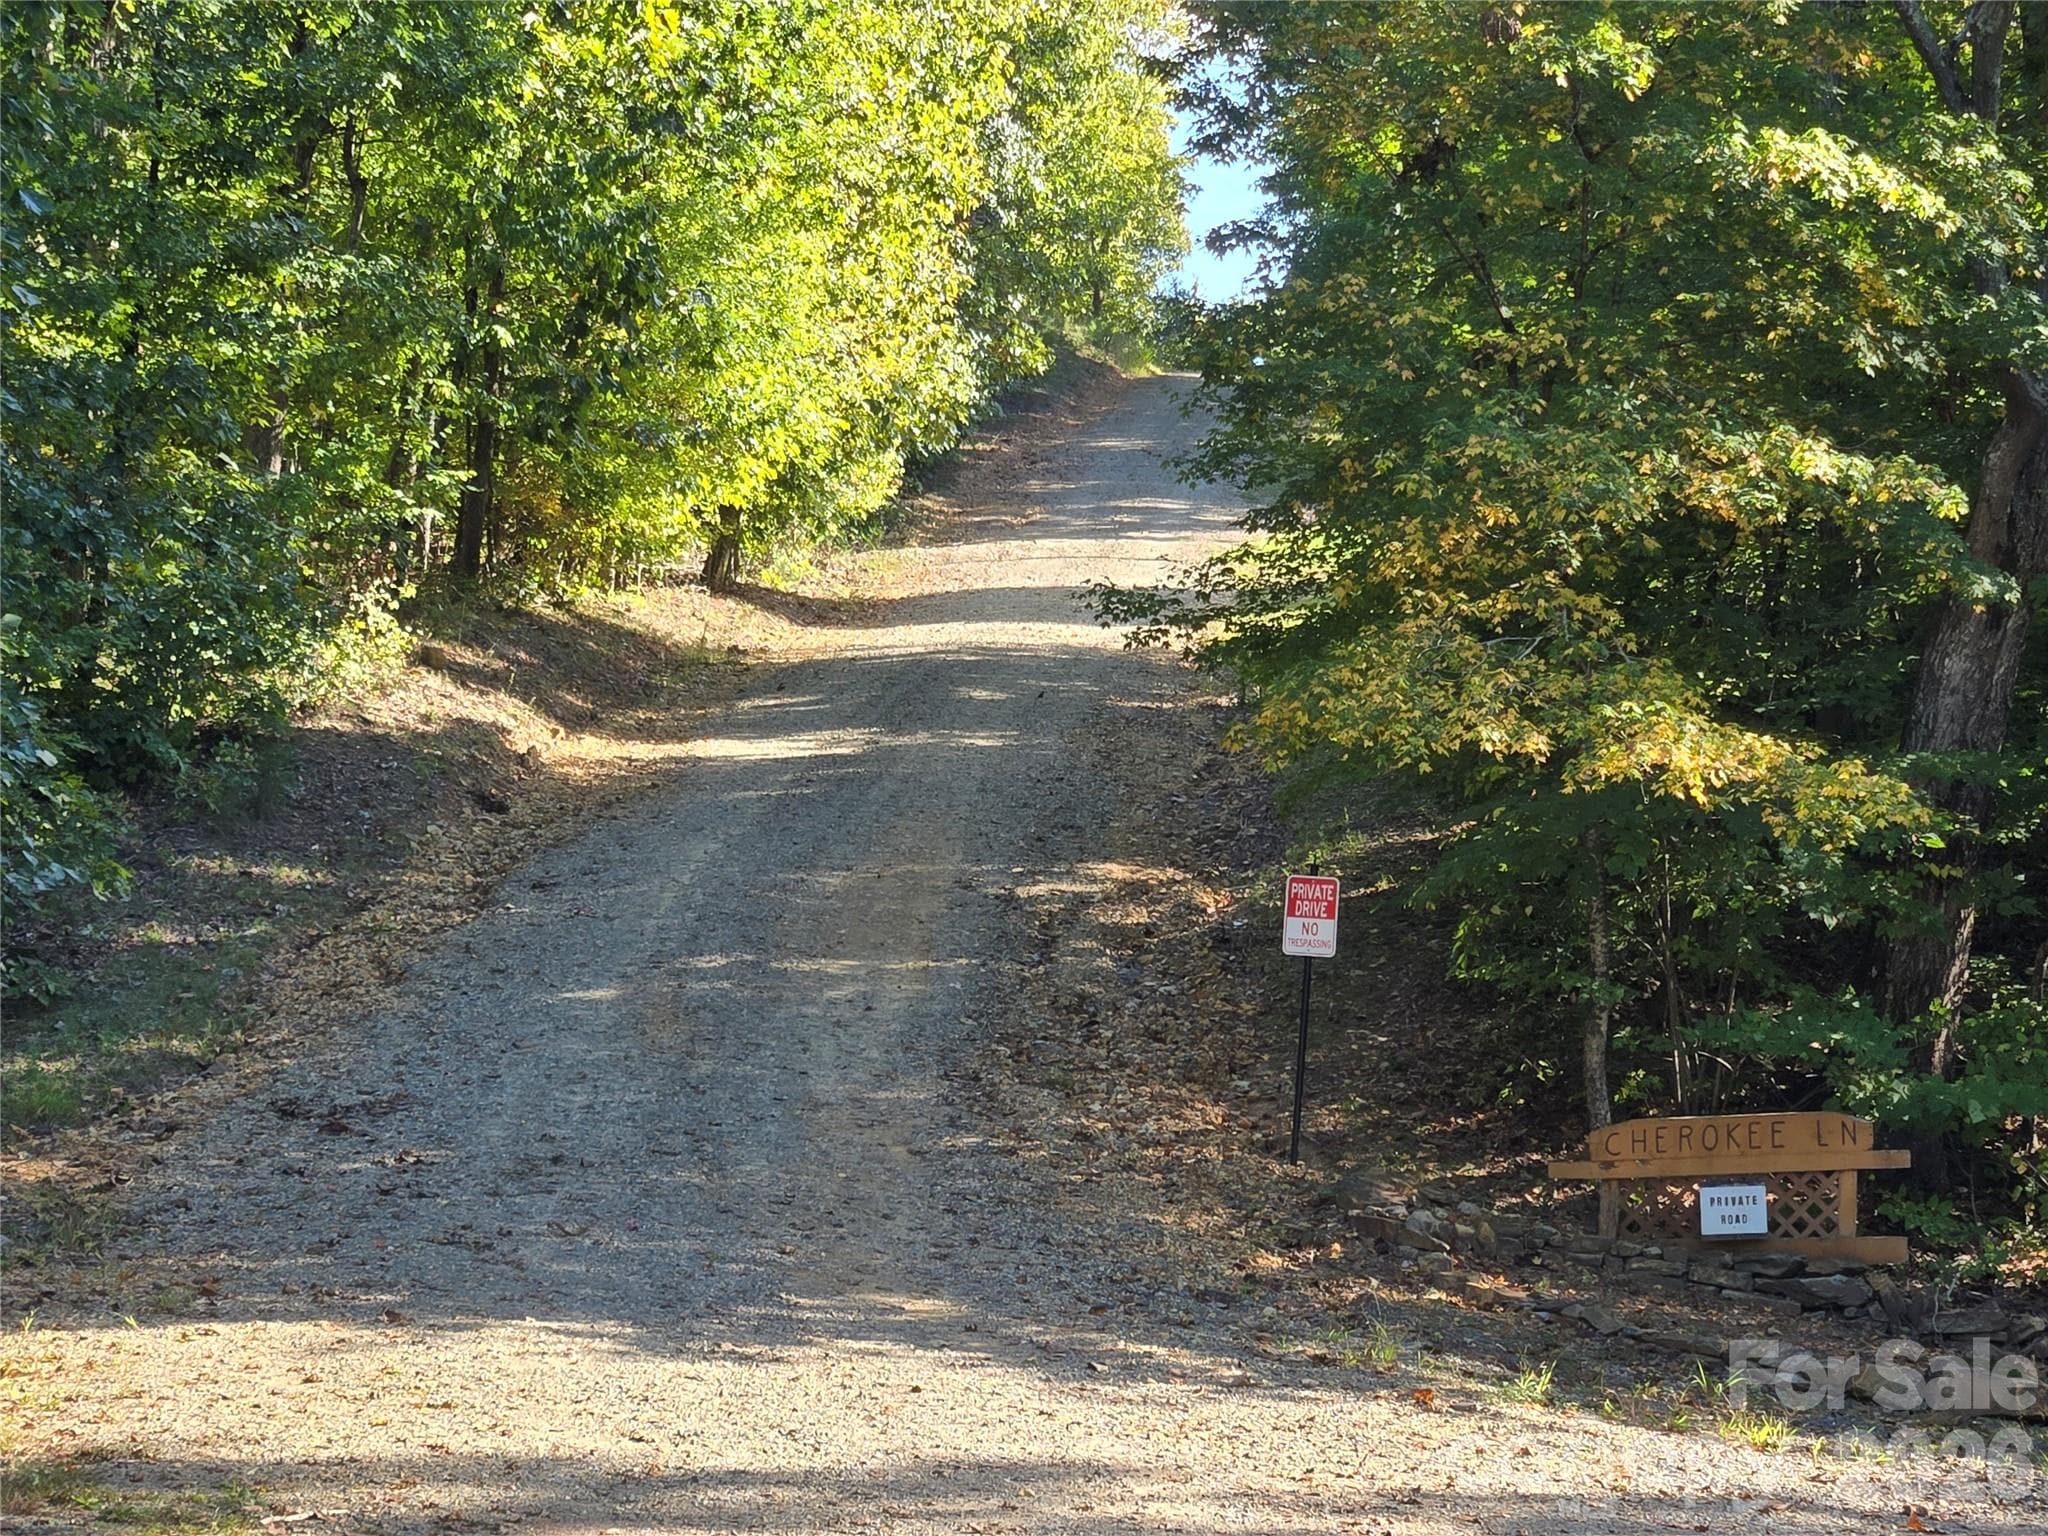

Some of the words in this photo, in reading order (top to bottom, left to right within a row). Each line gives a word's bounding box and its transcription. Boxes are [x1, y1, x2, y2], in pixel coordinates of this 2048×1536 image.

[1291, 883, 1334, 900] PRIVATE
[1295, 900, 1328, 918] DRIVE
[1301, 921, 1319, 937] NO
[1287, 937, 1332, 950] TRESPASSING
[1604, 1120, 1787, 1157] CHEROKEE
[1816, 1119, 1858, 1148] LN
[1709, 1195, 1758, 1207] PRIVATE
[1720, 1213, 1748, 1225] ROAD
